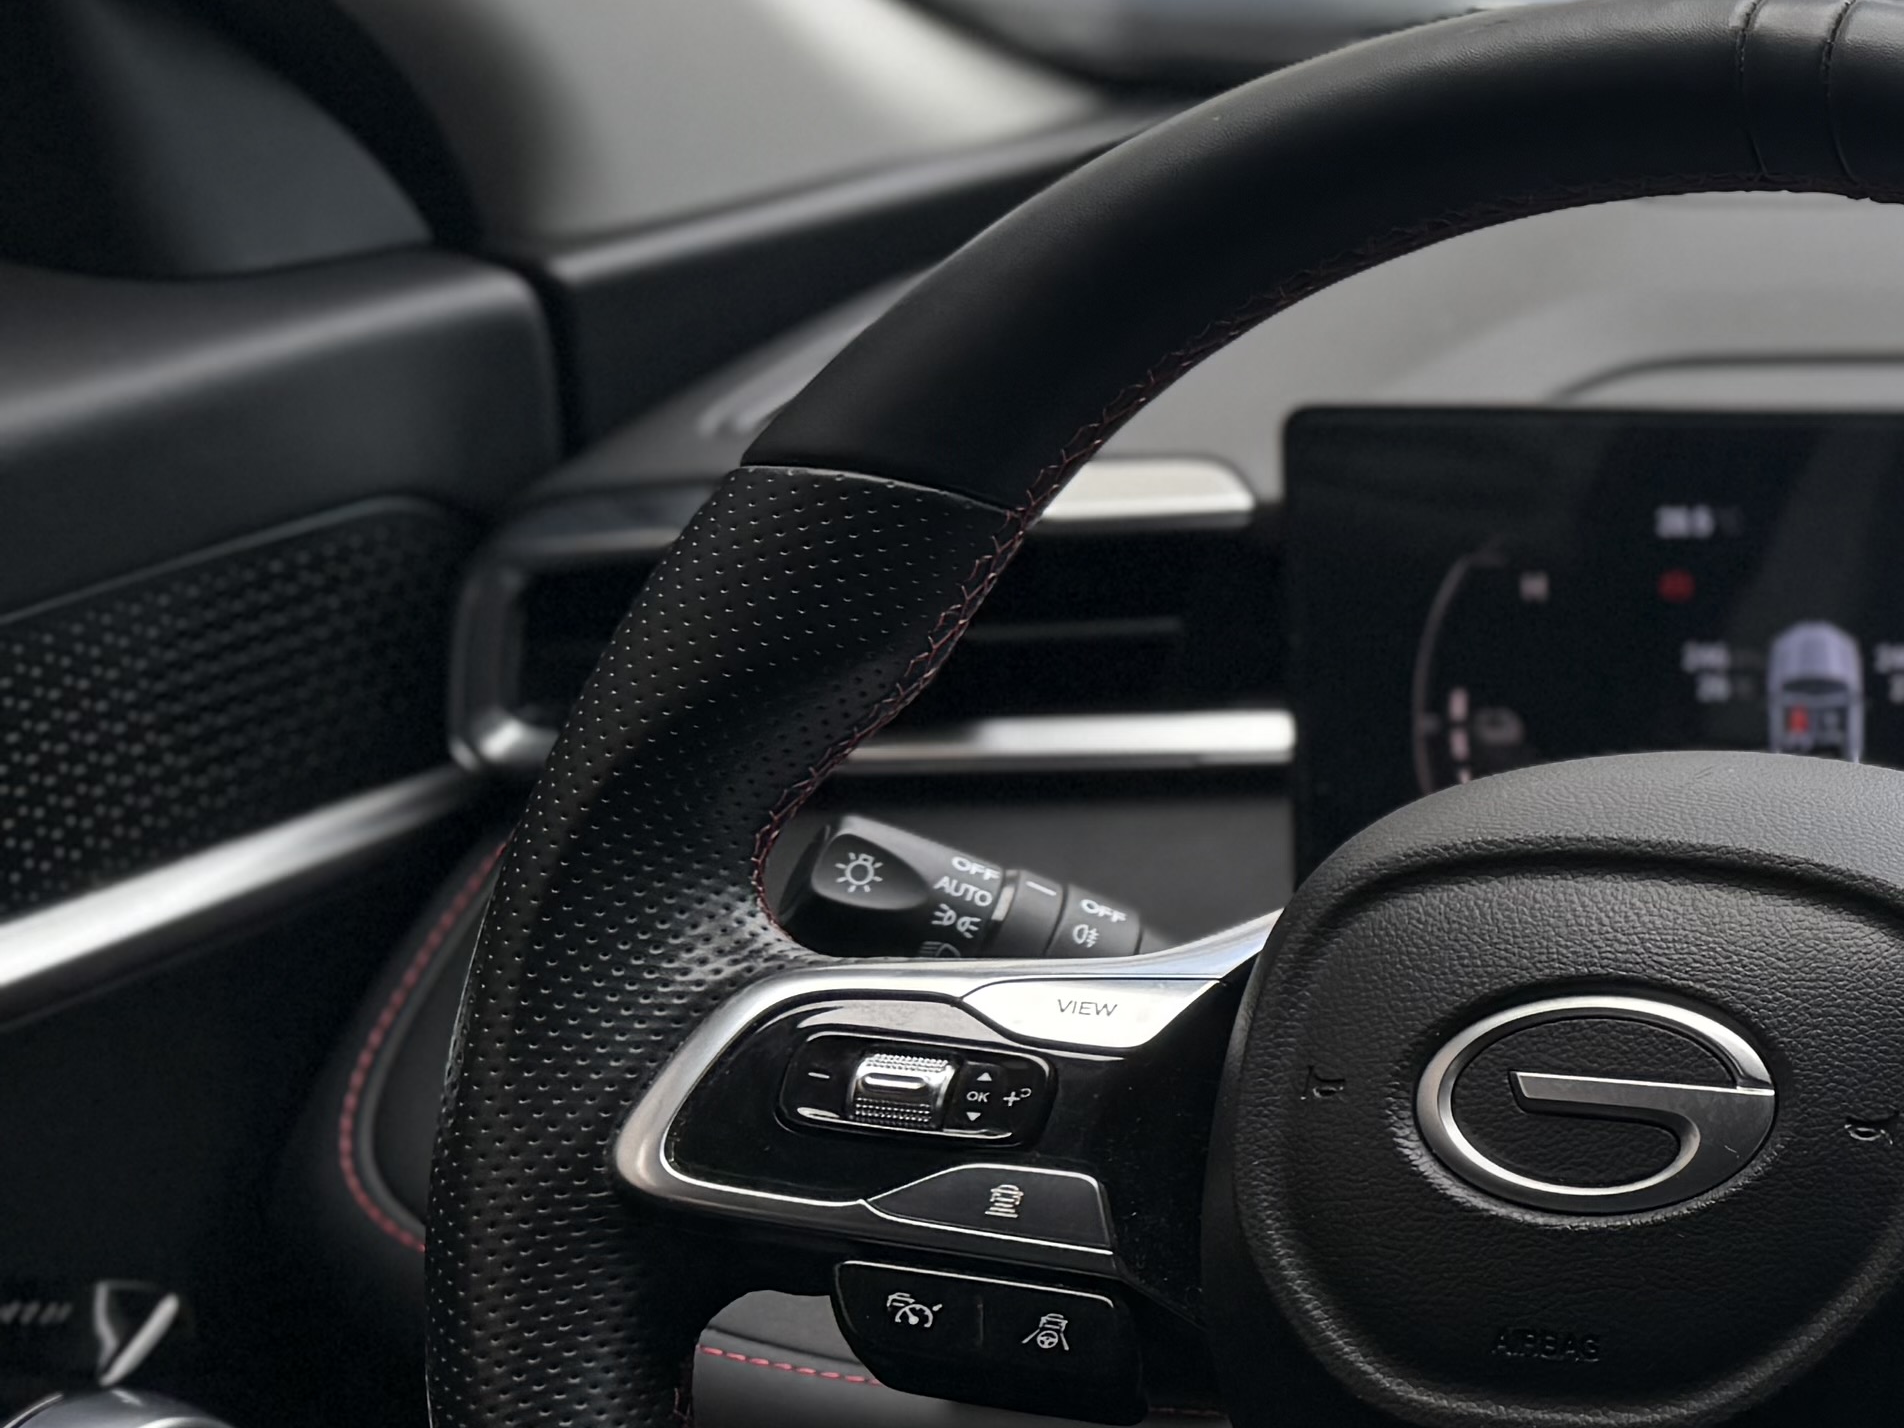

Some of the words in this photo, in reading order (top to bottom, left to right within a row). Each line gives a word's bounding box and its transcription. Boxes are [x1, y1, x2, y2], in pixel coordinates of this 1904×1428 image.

[951, 856, 1000, 880] OFF
[933, 875, 993, 907] AUTO
[1080, 898, 1127, 923] OFF
[1056, 998, 1119, 1018] VIEW
[966, 1090, 990, 1104] OK
